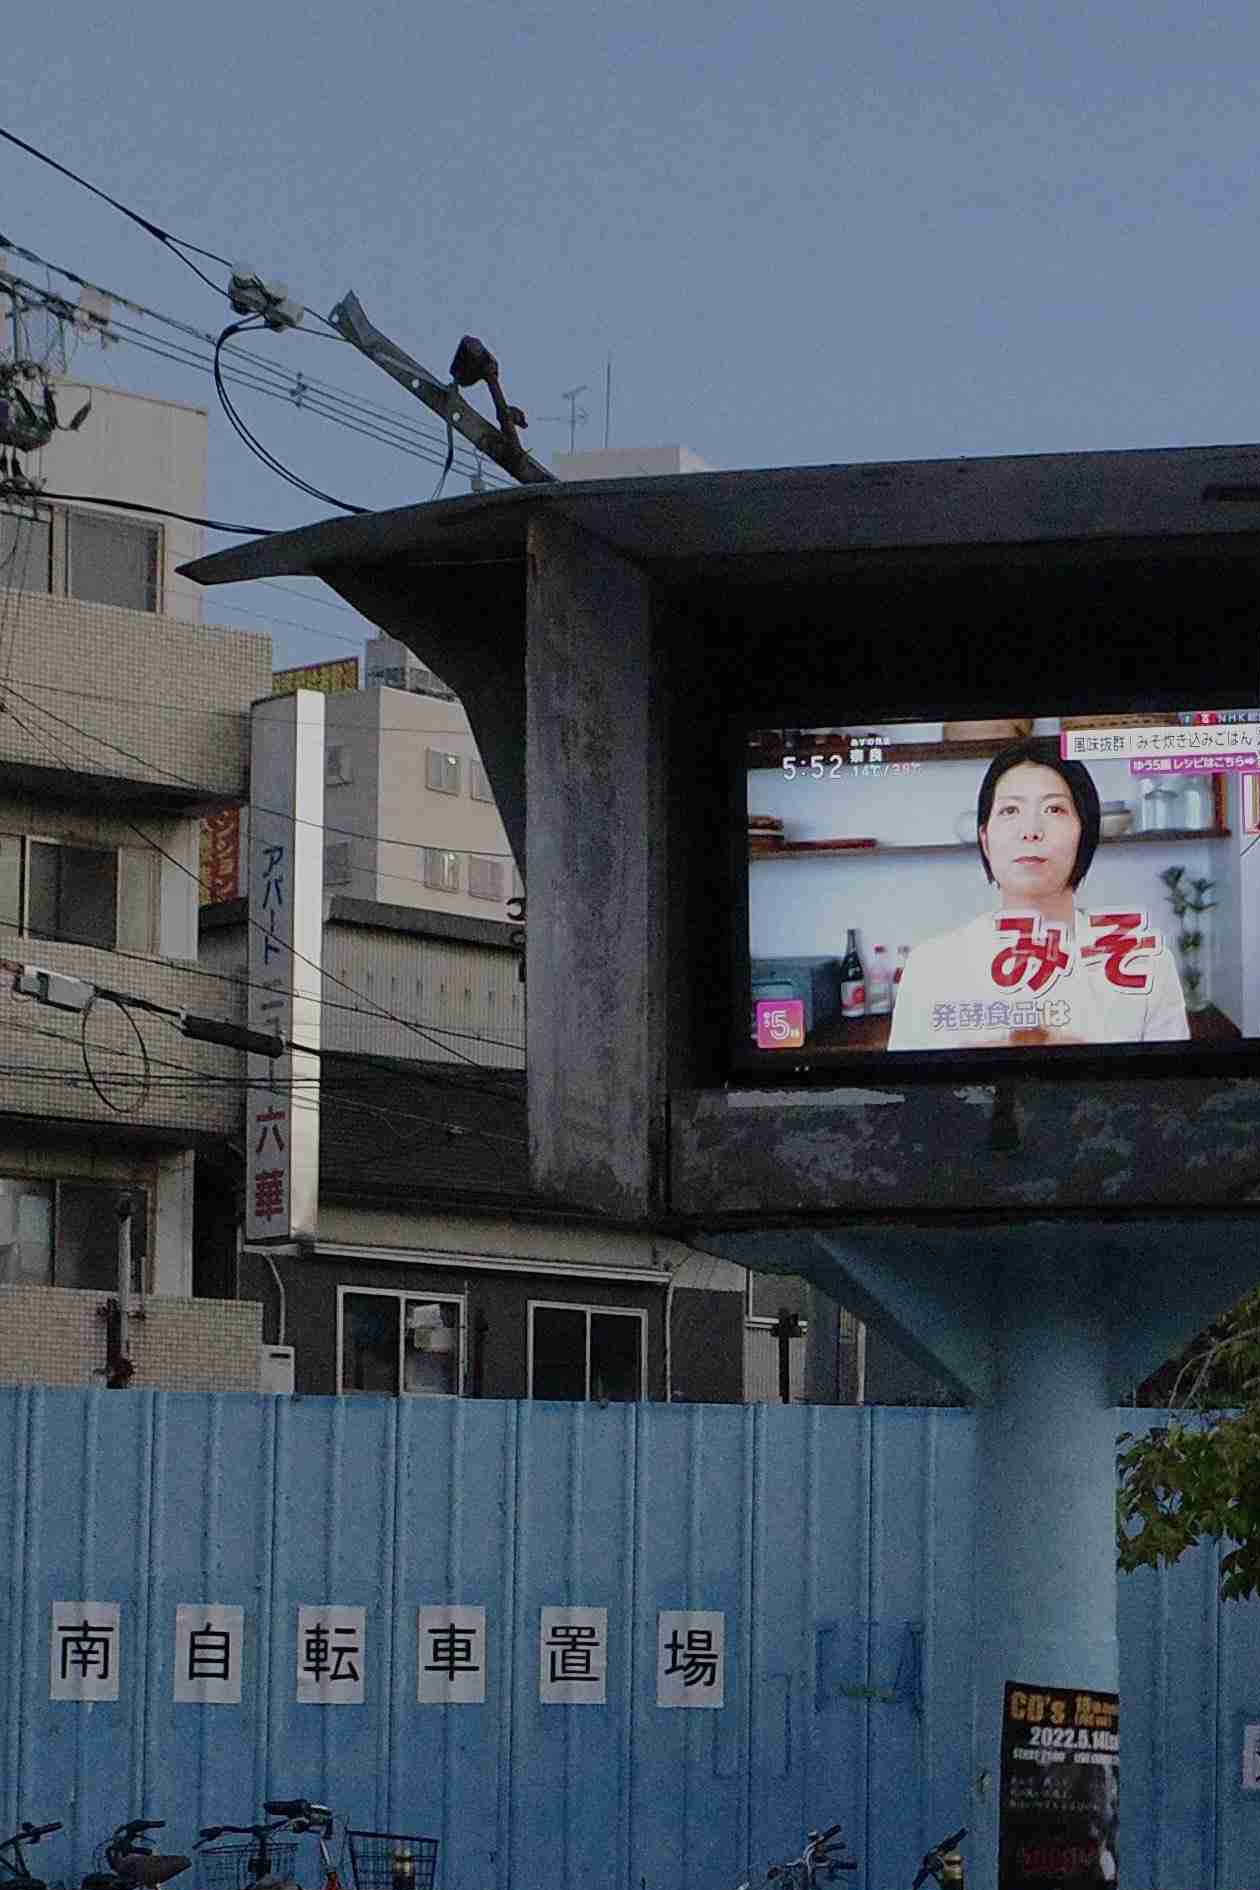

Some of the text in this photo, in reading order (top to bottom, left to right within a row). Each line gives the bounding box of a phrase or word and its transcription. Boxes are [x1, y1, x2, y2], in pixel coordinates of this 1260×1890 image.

[783, 754, 842, 781] 5:52
[989, 911, 1160, 994] みそ
[930, 1000, 1072, 1031] 発酵食品は
[57, 1619, 719, 1688] 南自転車置場
